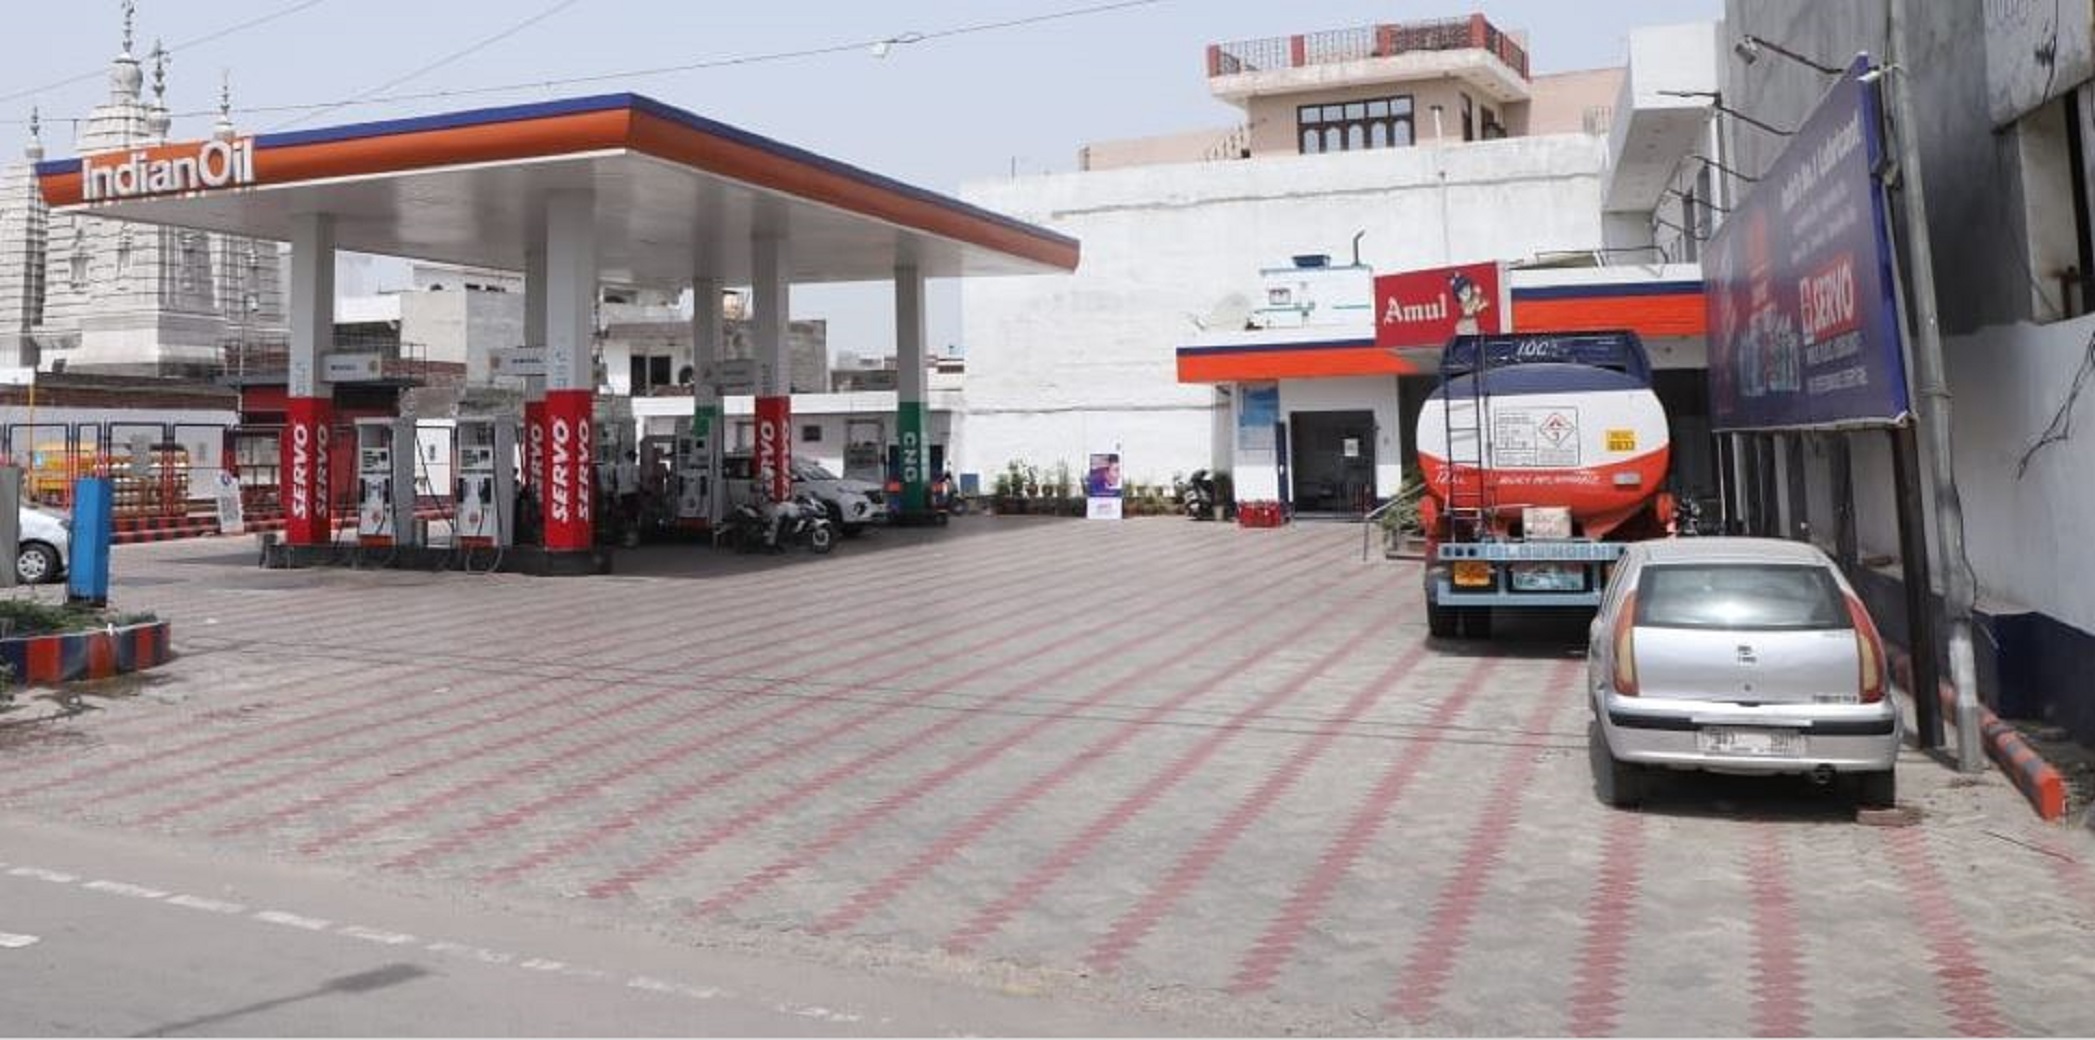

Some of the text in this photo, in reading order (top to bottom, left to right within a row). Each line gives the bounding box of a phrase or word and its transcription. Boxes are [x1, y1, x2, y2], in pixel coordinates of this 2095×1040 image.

[82, 138, 254, 201] IndianOil
[1384, 292, 1448, 326] Amul
[1812, 262, 1854, 333] SERVO
[293, 423, 308, 519] SERVO
[315, 424, 328, 518] SERVO
[552, 418, 570, 524] SERVO
[578, 419, 589, 522] SERVO
[903, 431, 918, 483] CNG
